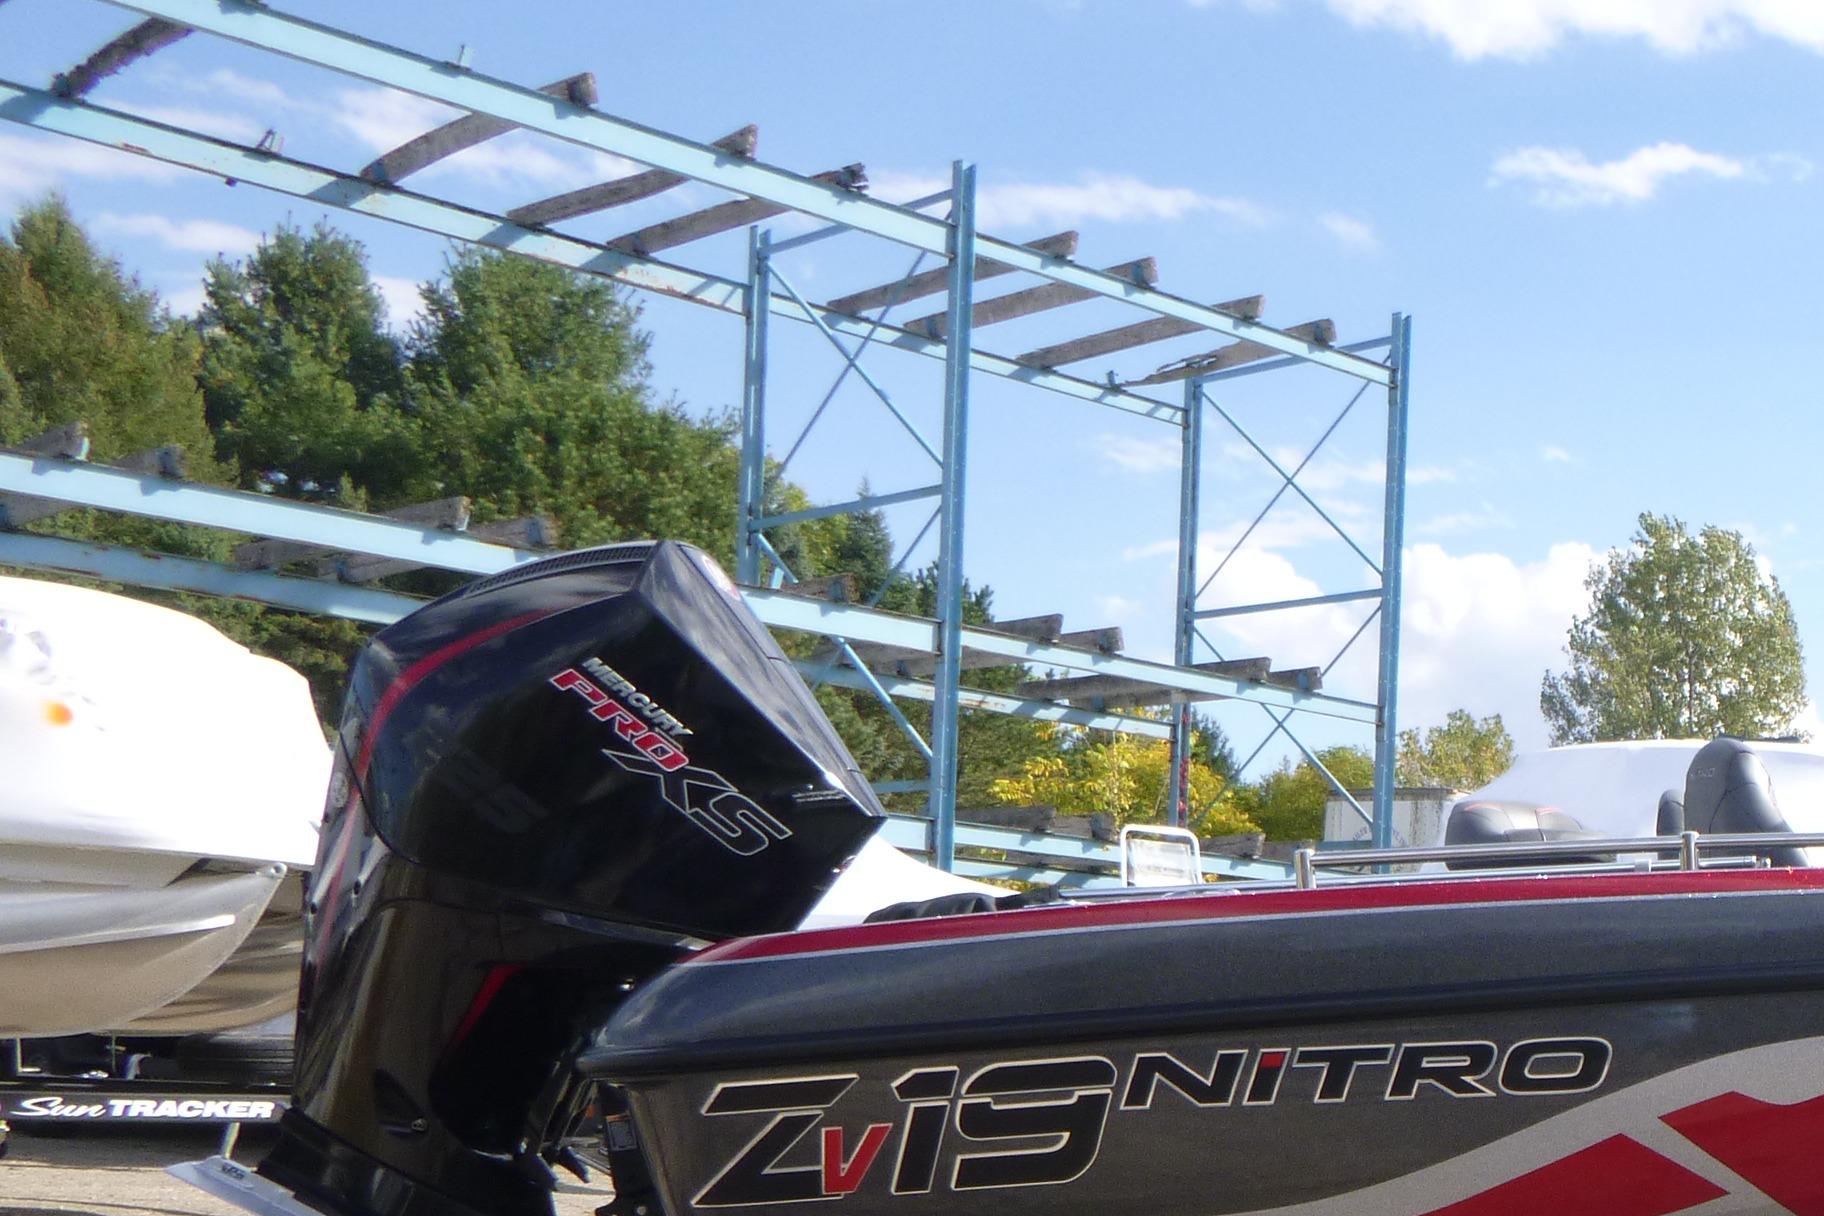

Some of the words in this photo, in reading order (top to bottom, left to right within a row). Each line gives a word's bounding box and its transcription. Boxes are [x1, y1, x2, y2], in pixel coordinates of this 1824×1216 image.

[547, 668, 690, 772] PRO
[581, 656, 693, 737] MERCURY
[601, 747, 793, 856] XS
[11, 1096, 106, 1117] Sun
[108, 1099, 275, 1118] TRACKER
[1119, 1036, 1613, 1110] NITRO
